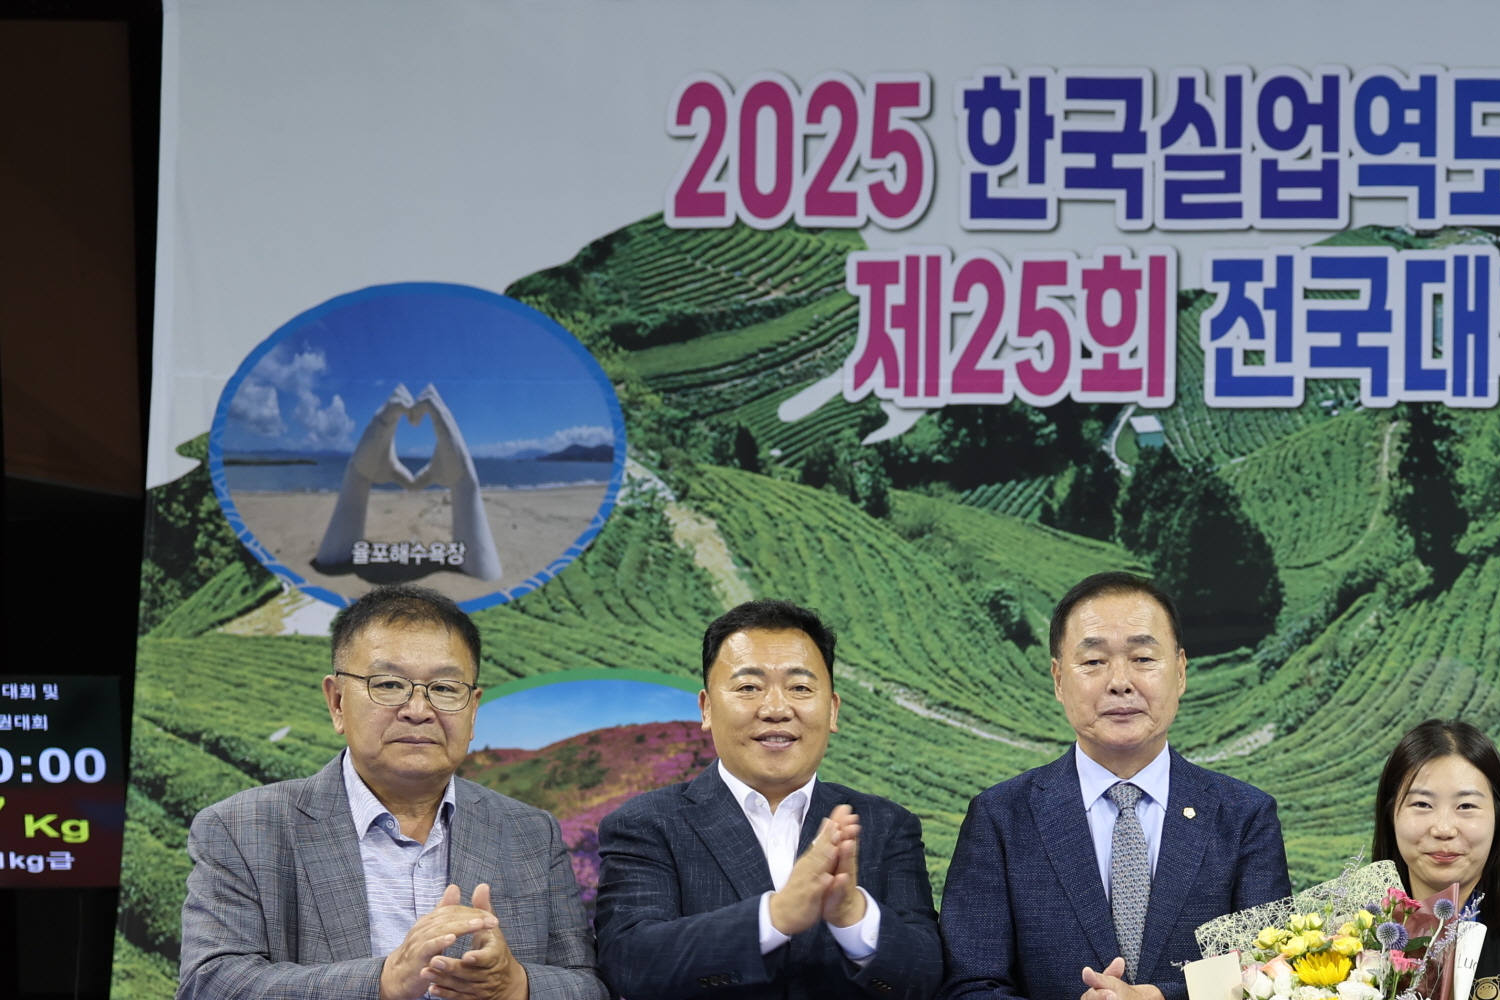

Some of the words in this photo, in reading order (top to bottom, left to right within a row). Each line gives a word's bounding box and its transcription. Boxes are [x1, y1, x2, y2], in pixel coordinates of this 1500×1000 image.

[673, 79, 924, 219] 2025
[852, 254, 1168, 398] 제25회
[350, 540, 469, 566] 율포해수욕장
[42, 683, 60, 701] 및
[24, 813, 90, 844] Kg
